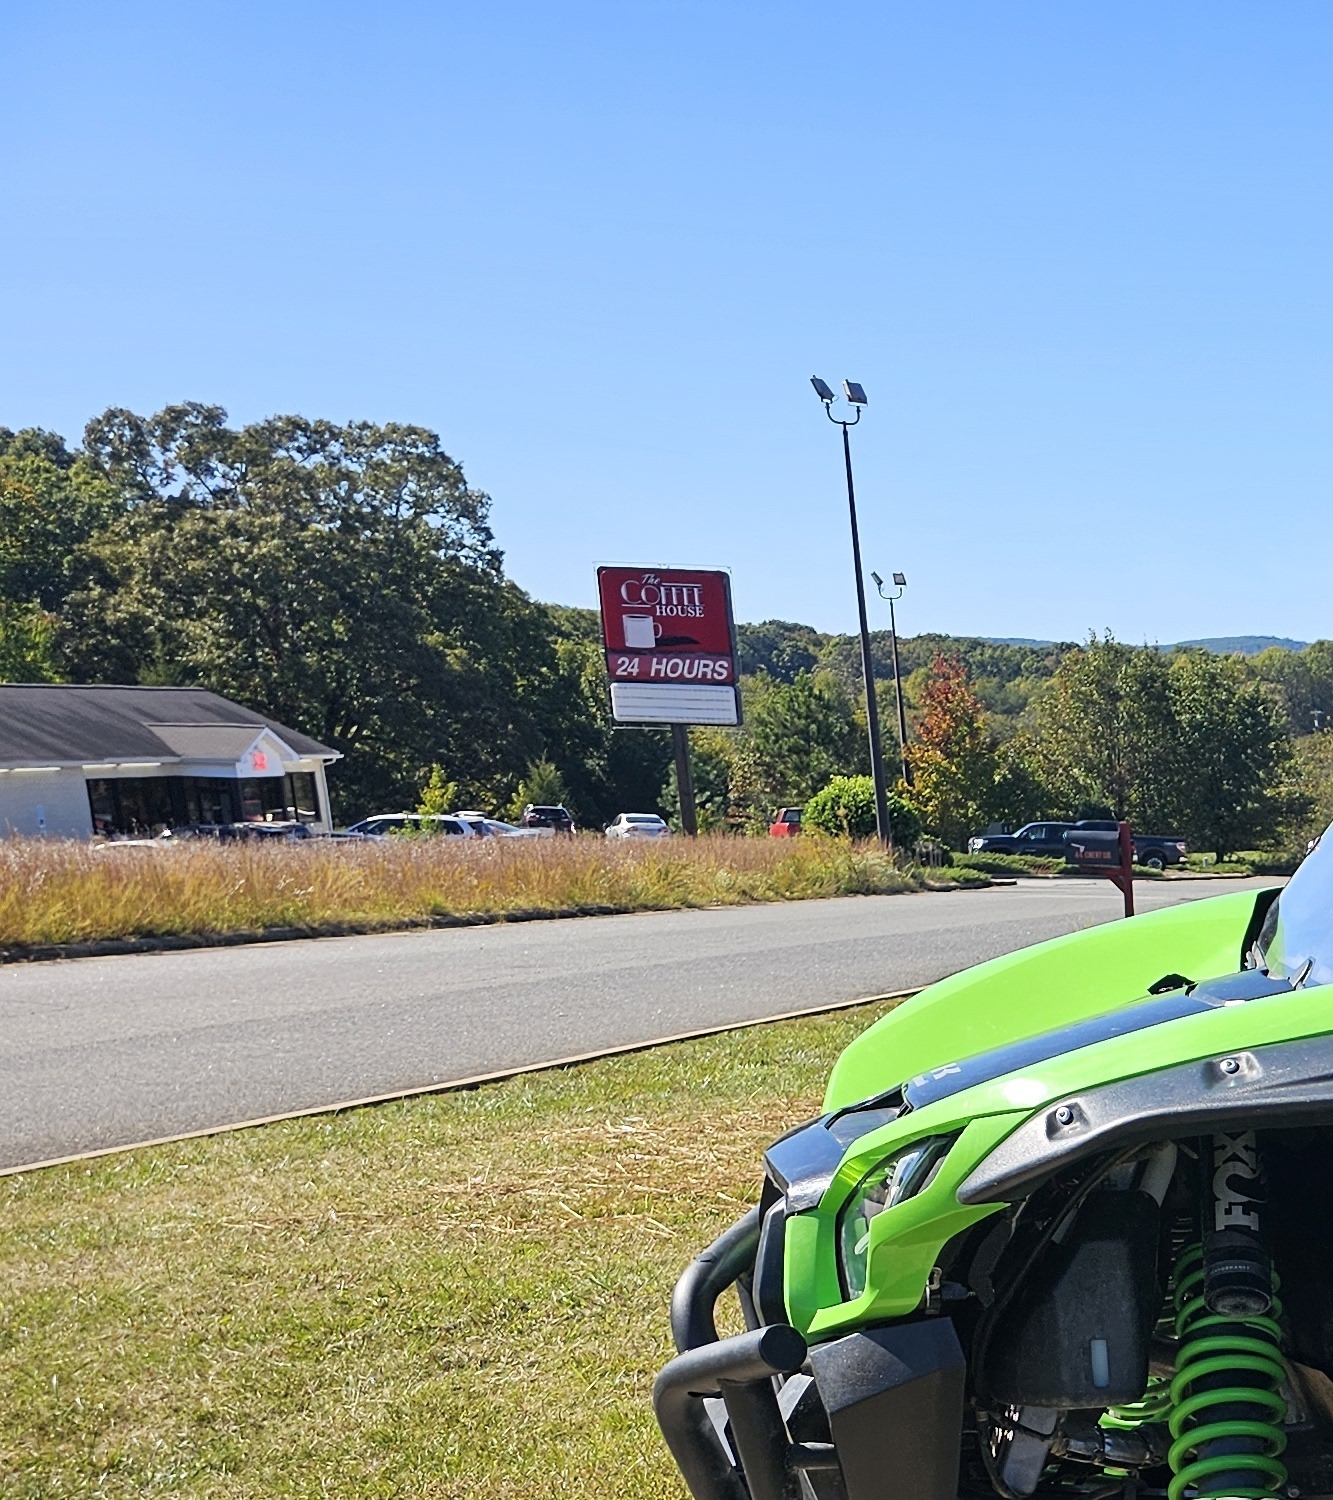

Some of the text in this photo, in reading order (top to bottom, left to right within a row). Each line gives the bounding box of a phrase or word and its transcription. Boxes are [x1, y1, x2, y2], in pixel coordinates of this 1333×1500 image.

[641, 573, 661, 585] The
[620, 580, 704, 606] COFFEE
[655, 605, 704, 618] HOUSE
[616, 657, 729, 680] 24 HOURS
